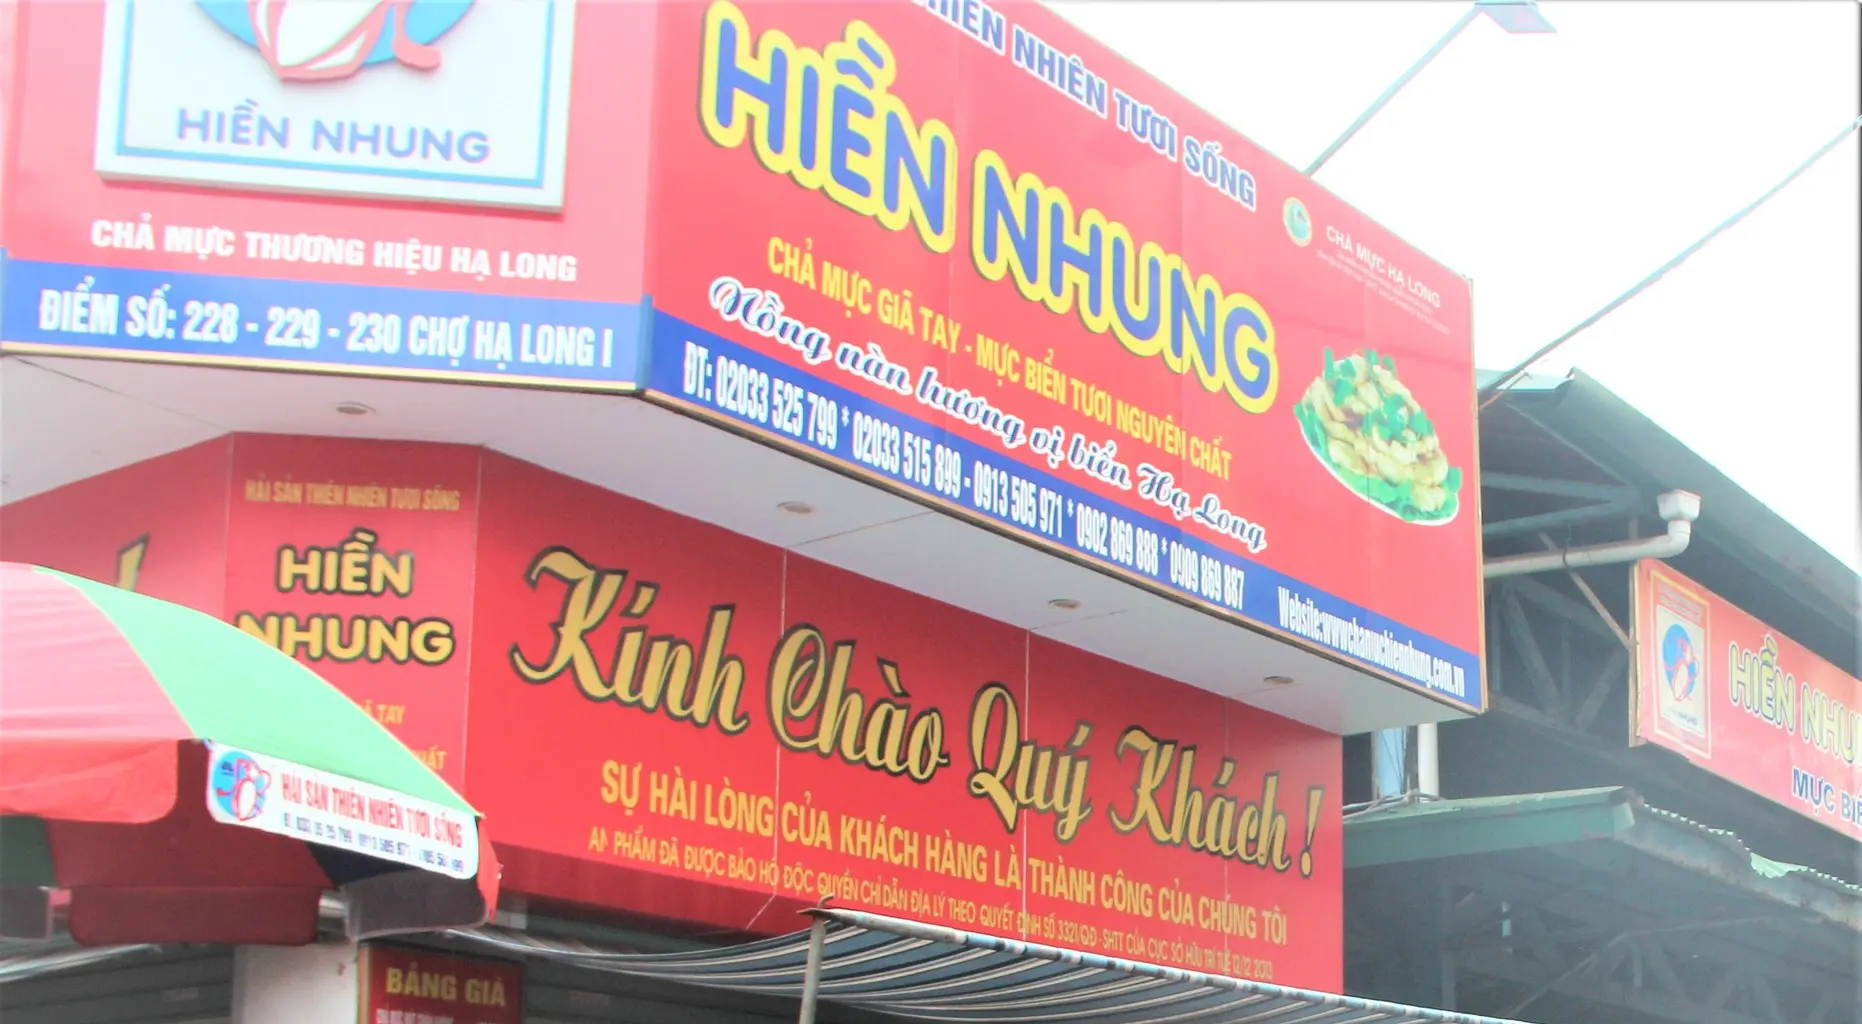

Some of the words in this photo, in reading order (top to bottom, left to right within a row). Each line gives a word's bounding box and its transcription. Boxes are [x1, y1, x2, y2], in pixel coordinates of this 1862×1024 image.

[176, 98, 289, 148] HIỀN
[312, 120, 490, 163] NHUNG
[701, 1, 955, 253] HIỀN
[1012, 24, 1107, 118] NHIÊN
[1114, 88, 1177, 161] TƯƠI
[1184, 136, 1256, 212] SỐNG
[91, 212, 154, 250] CHẢ
[164, 225, 234, 261] MỰC
[244, 231, 364, 266] THƯƠNG
[373, 238, 441, 275] HIỆU
[451, 247, 490, 280] HẠ
[499, 251, 576, 281] LONG
[973, 150, 1278, 413] NHUNG
[1408, 276, 1440, 308] LONG
[40, 277, 118, 334] ĐIỂM
[125, 284, 176, 339] SỐ:
[182, 301, 238, 343] 228
[265, 307, 320, 349] 229
[346, 312, 400, 353] 230
[408, 315, 469, 366] CHỢ
[473, 320, 511, 369] HẠ
[521, 323, 594, 366] LONG
[768, 236, 816, 290] CHẢ
[822, 261, 872, 318] MỰC
[877, 287, 915, 336] GIÃ
[919, 306, 960, 353] TAY
[976, 334, 1020, 387] MỰC
[1024, 348, 1066, 406] BIỂN
[1070, 378, 1112, 426] TƯƠI
[1116, 399, 1186, 460] NGUYÊN
[1190, 436, 1231, 481] CHẤT
[684, 341, 712, 402] ĐT:
[715, 355, 770, 423] 02033
[772, 378, 803, 437] 525
[807, 392, 838, 450] 799
[853, 411, 900, 475] 02033
[903, 431, 932, 487] 515
[934, 443, 962, 498] 899
[973, 460, 1008, 519] 0913
[1011, 475, 1036, 529] 505
[1039, 487, 1063, 539] 971
[1076, 502, 1108, 557] 0902
[1110, 516, 1134, 566] 869
[1136, 528, 1159, 577] 888
[1169, 540, 1198, 593] 0909
[1200, 554, 1222, 602] 869
[1224, 564, 1244, 611] 887
[836, 342, 912, 395] nàn
[916, 367, 1026, 449] hương
[1030, 425, 1064, 469] vị
[1068, 433, 1132, 490] biển
[1137, 462, 1191, 521] Hạ
[1192, 494, 1267, 553] Long
[277, 526, 414, 598] HIỀN
[508, 544, 750, 736] Kính
[767, 622, 951, 784] Chào
[966, 680, 1094, 845] Quý
[1109, 724, 1292, 872] Khách
[1729, 634, 1795, 732] HIỀN
[1801, 682, 1862, 768] NHU
[601, 759, 641, 819] SỰ
[649, 766, 697, 821] HÀI
[704, 776, 774, 837] LÒNG
[781, 791, 832, 851] CỦA
[840, 814, 919, 869] KHÁCH
[924, 830, 987, 883] HÀNG
[994, 846, 1021, 890] LÀ
[1028, 857, 1095, 906] THÀNH
[1100, 868, 1153, 917] CÔNG
[1158, 877, 1195, 925] CỦA
[1199, 893, 1257, 940] CHÚNG
[1262, 907, 1287, 945] TÔI
[1792, 766, 1835, 814] MỰC
[614, 825, 655, 863] PHẨM
[660, 837, 679, 867] ĐÃ
[684, 845, 726, 879] ĐƯỢC
[729, 848, 756, 881] BẢO
[783, 862, 814, 895] ĐỘC
[911, 888, 931, 918] ĐỊA
[933, 890, 946, 918] LÝ
[948, 897, 975, 924] THEO
[980, 902, 1014, 931] QUYẾT
[386, 962, 457, 1000] BẢNG
[464, 976, 506, 1006] GIÁ
